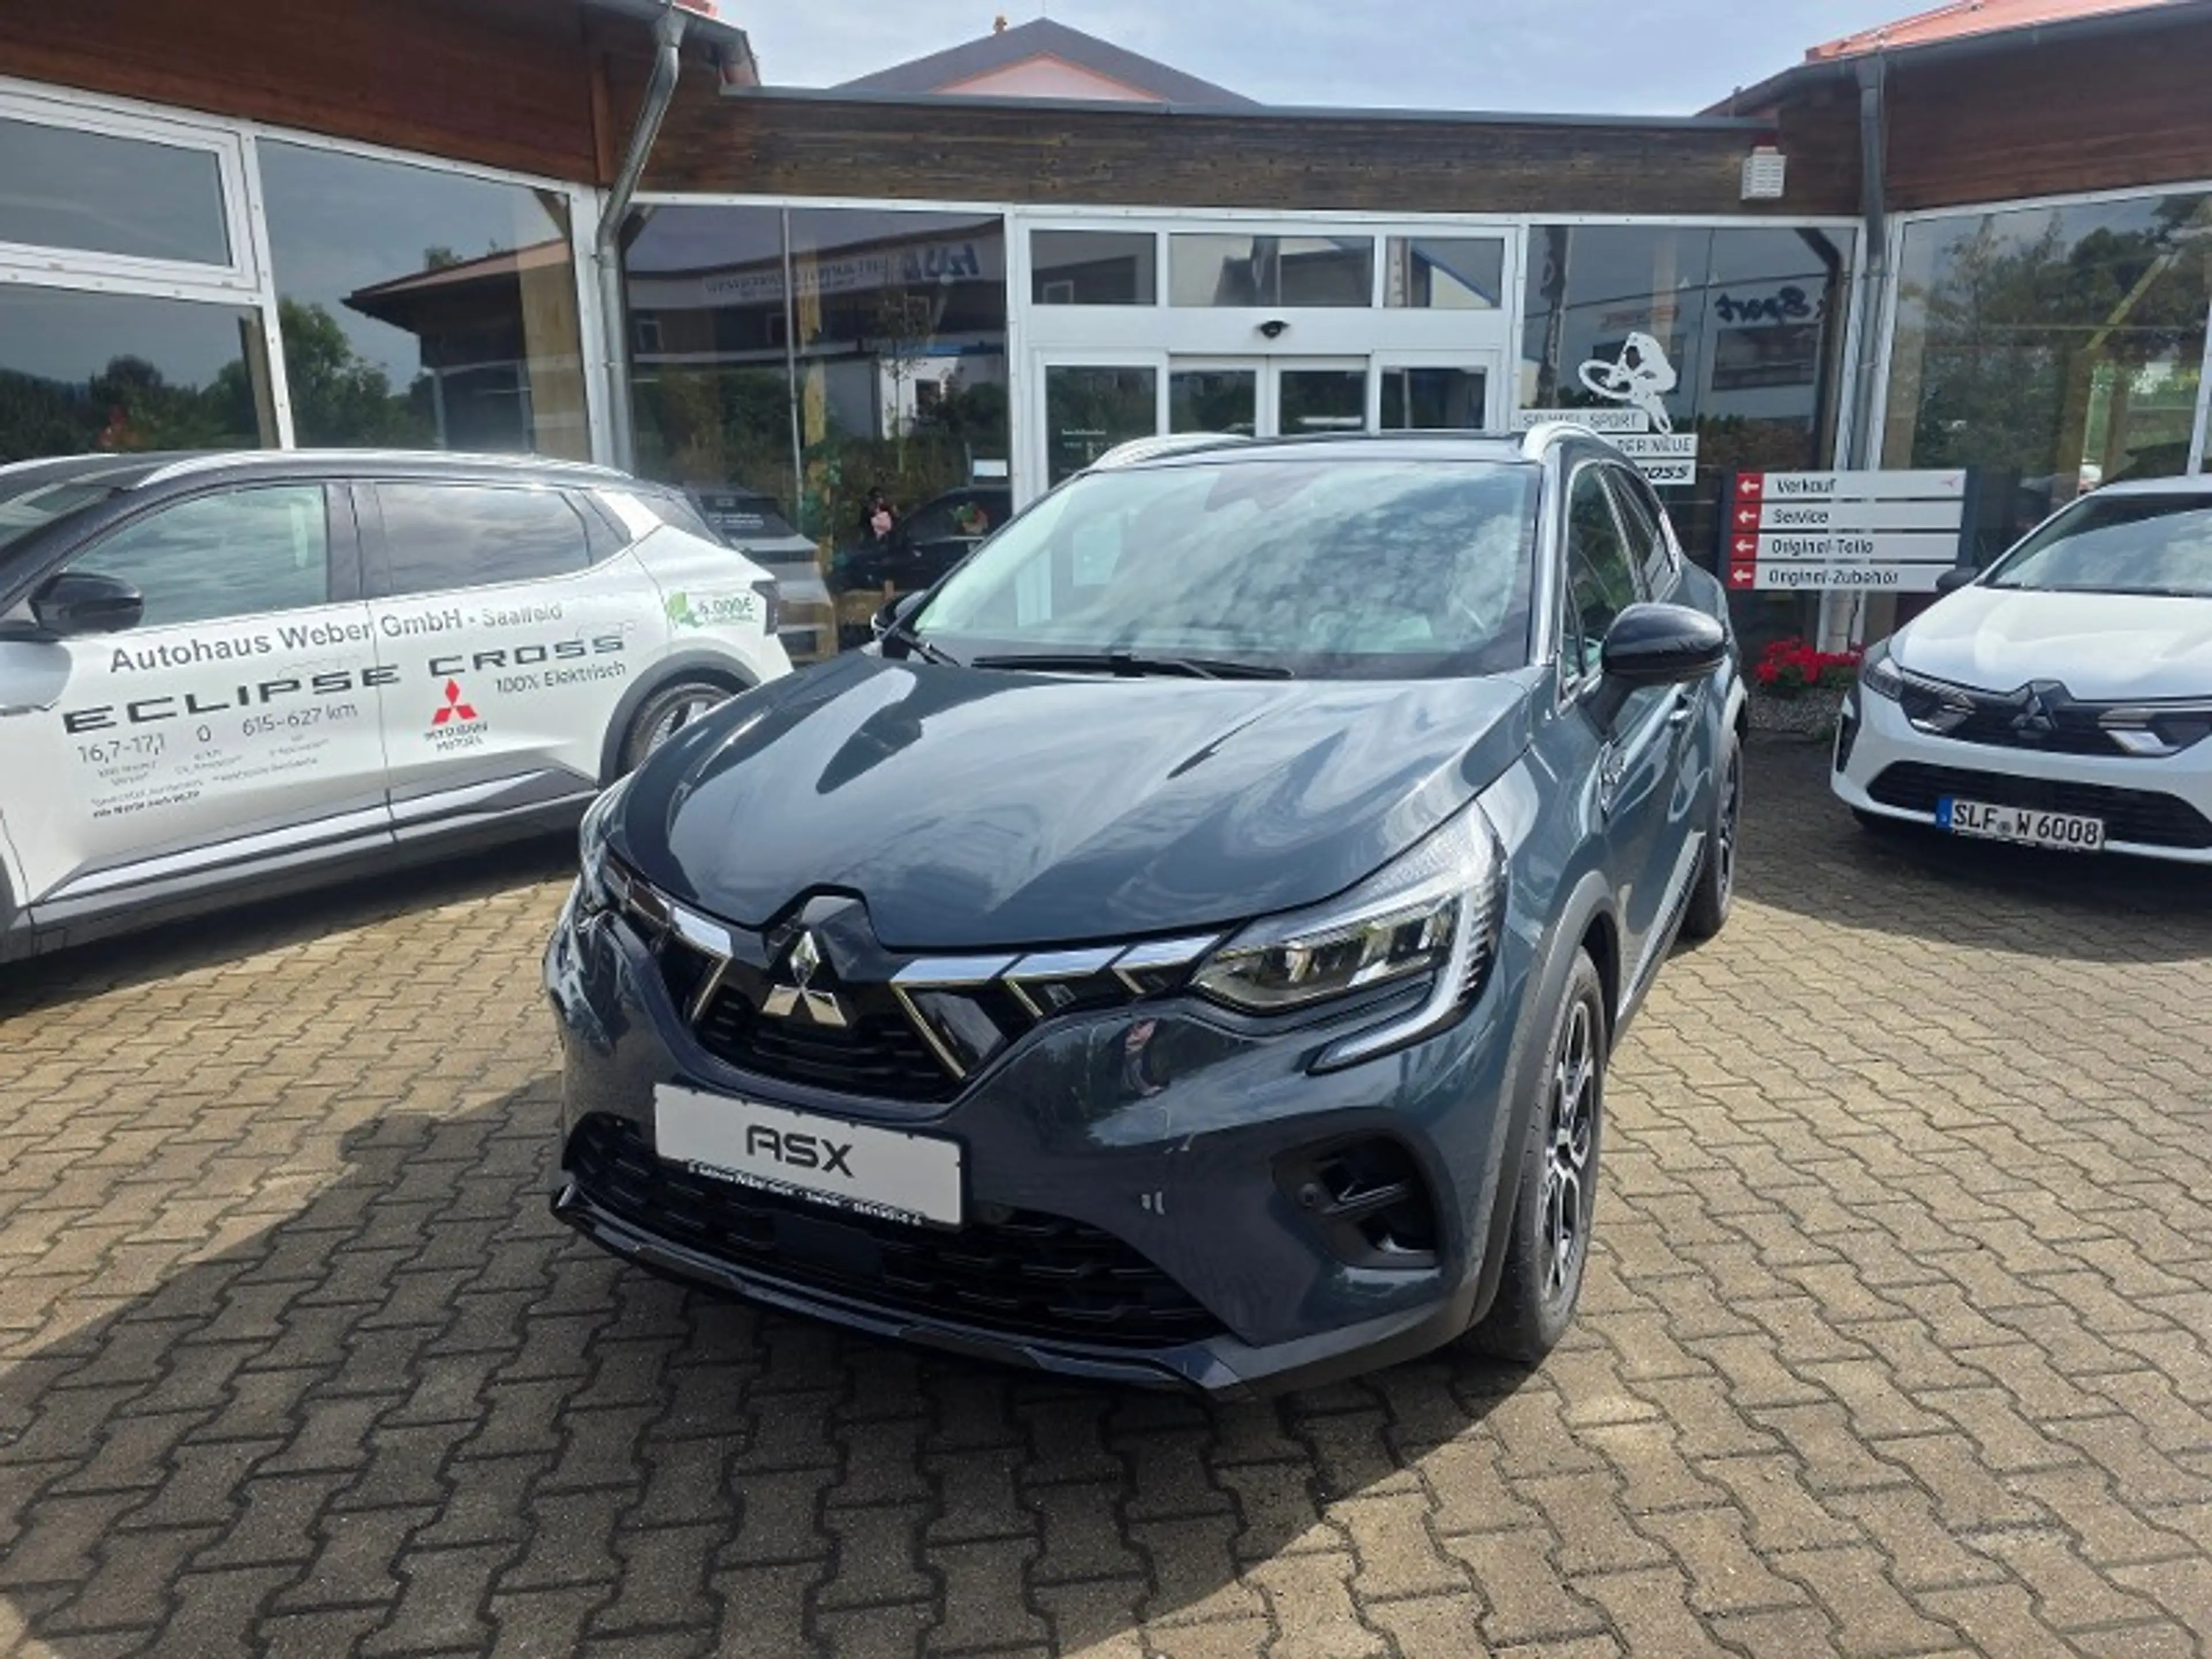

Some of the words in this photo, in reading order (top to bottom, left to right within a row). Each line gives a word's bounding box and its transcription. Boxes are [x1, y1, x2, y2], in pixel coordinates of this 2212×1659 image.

[1777, 478, 1836, 493] Verkauf
[1773, 510, 1829, 524] Service
[1771, 539, 1873, 556] Original-Teile
[110, 634, 272, 673] Autohaus
[276, 620, 372, 649] Weber
[380, 607, 461, 637] GmbH
[483, 603, 562, 627] Saalfeld
[63, 664, 400, 734] ECLIPSE
[429, 635, 625, 677] CROSS
[496, 672, 540, 694] 100%
[544, 662, 626, 687] Elektrisch
[196, 724, 211, 743] 0
[242, 706, 321, 738] 615-627
[325, 704, 358, 722] km
[1954, 804, 1998, 830] SLF
[2017, 811, 2031, 836] W
[2037, 815, 2100, 845] 6008
[746, 1124, 854, 1179] ASX
